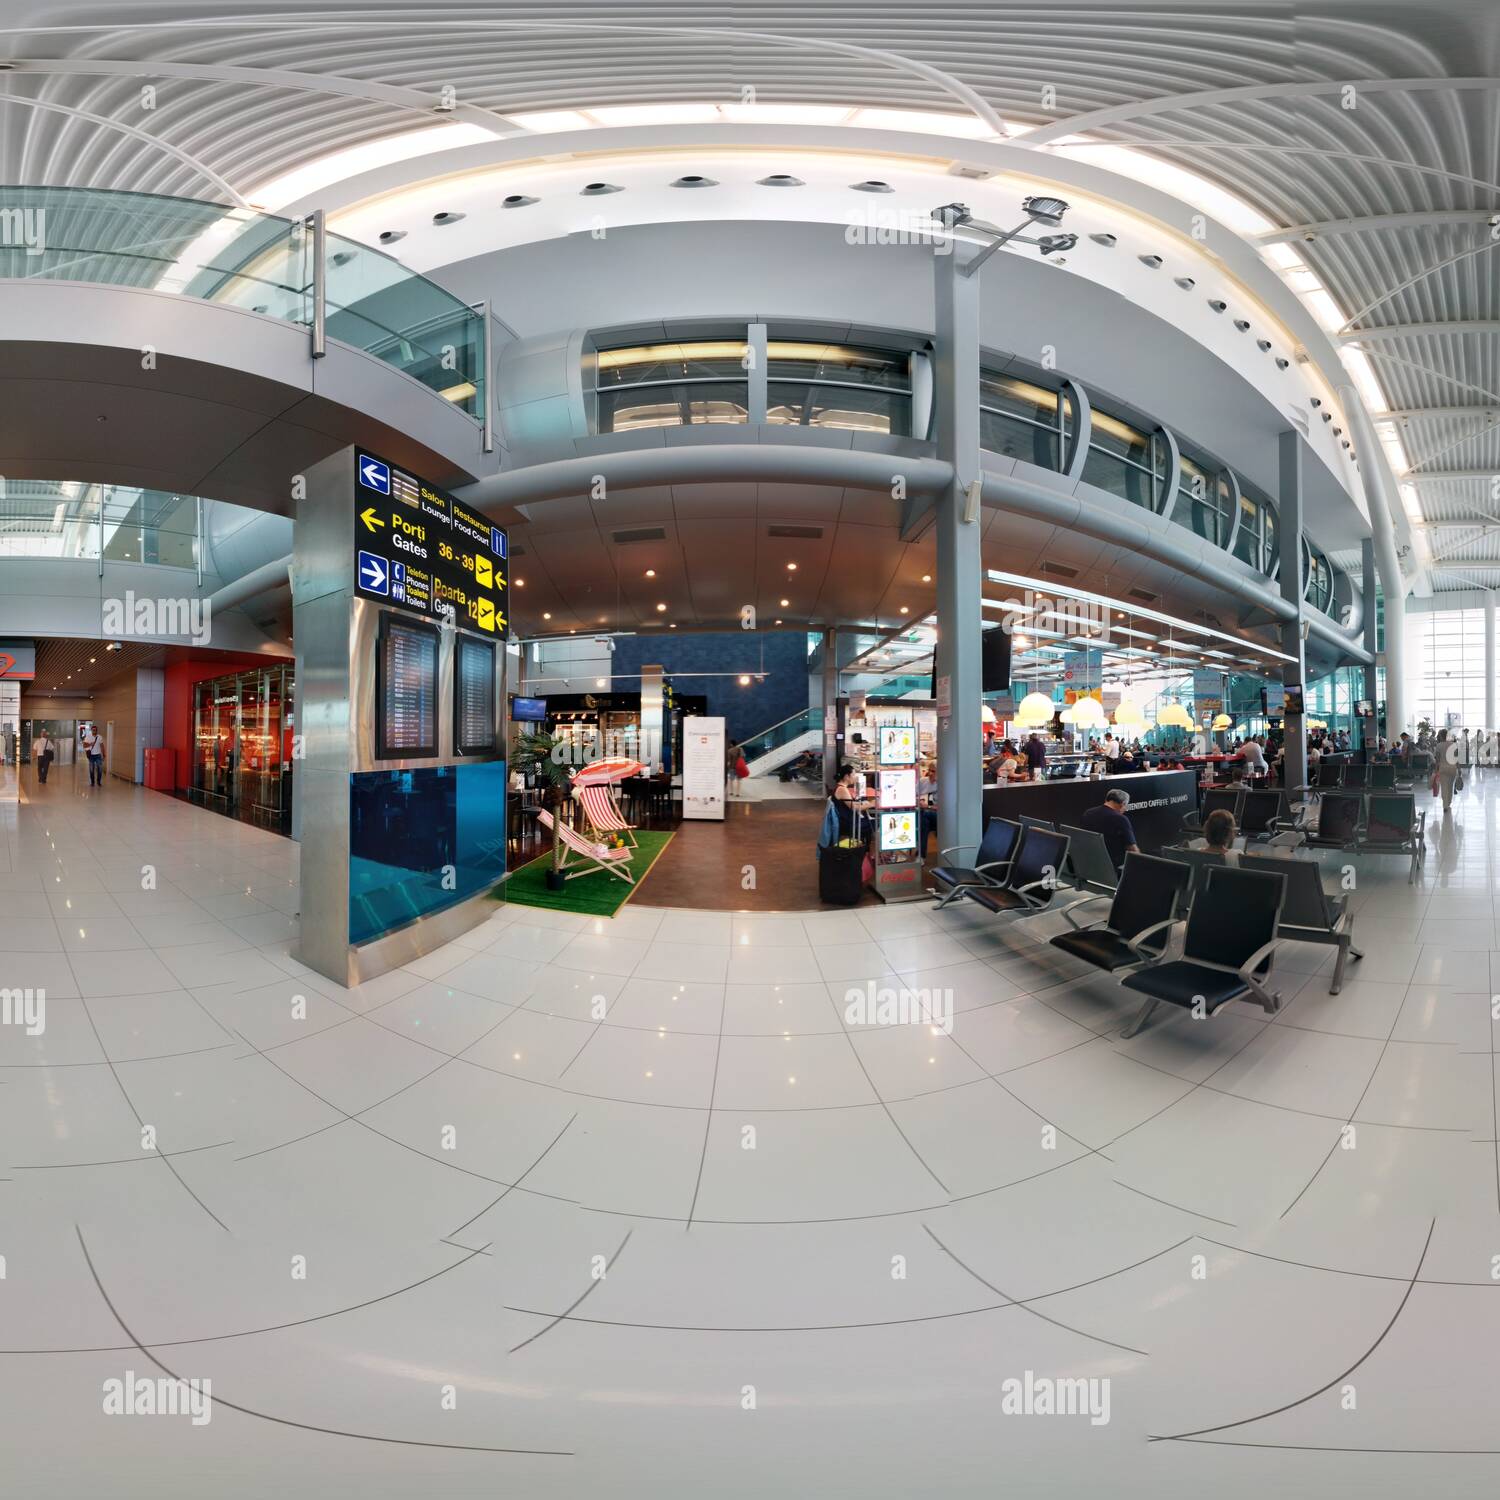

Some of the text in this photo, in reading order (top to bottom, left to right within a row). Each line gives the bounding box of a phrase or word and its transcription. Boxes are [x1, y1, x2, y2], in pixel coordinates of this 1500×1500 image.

[422, 488, 445, 507] Salon
[422, 502, 450, 524] Lounge
[454, 506, 490, 534] Restaurant
[392, 514, 426, 543] Porți
[454, 520, 490, 546] Food Court
[392, 534, 428, 558] Gates
[438, 542, 453, 560] 36
[462, 554, 474, 572] 39
[406, 565, 428, 581] Telefon
[406, 577, 429, 591] Phones
[406, 585, 428, 600] Toalete
[434, 578, 466, 604] Poarta
[406, 595, 426, 610] Toilets
[434, 598, 455, 617] Gate
[468, 600, 478, 620] 12
